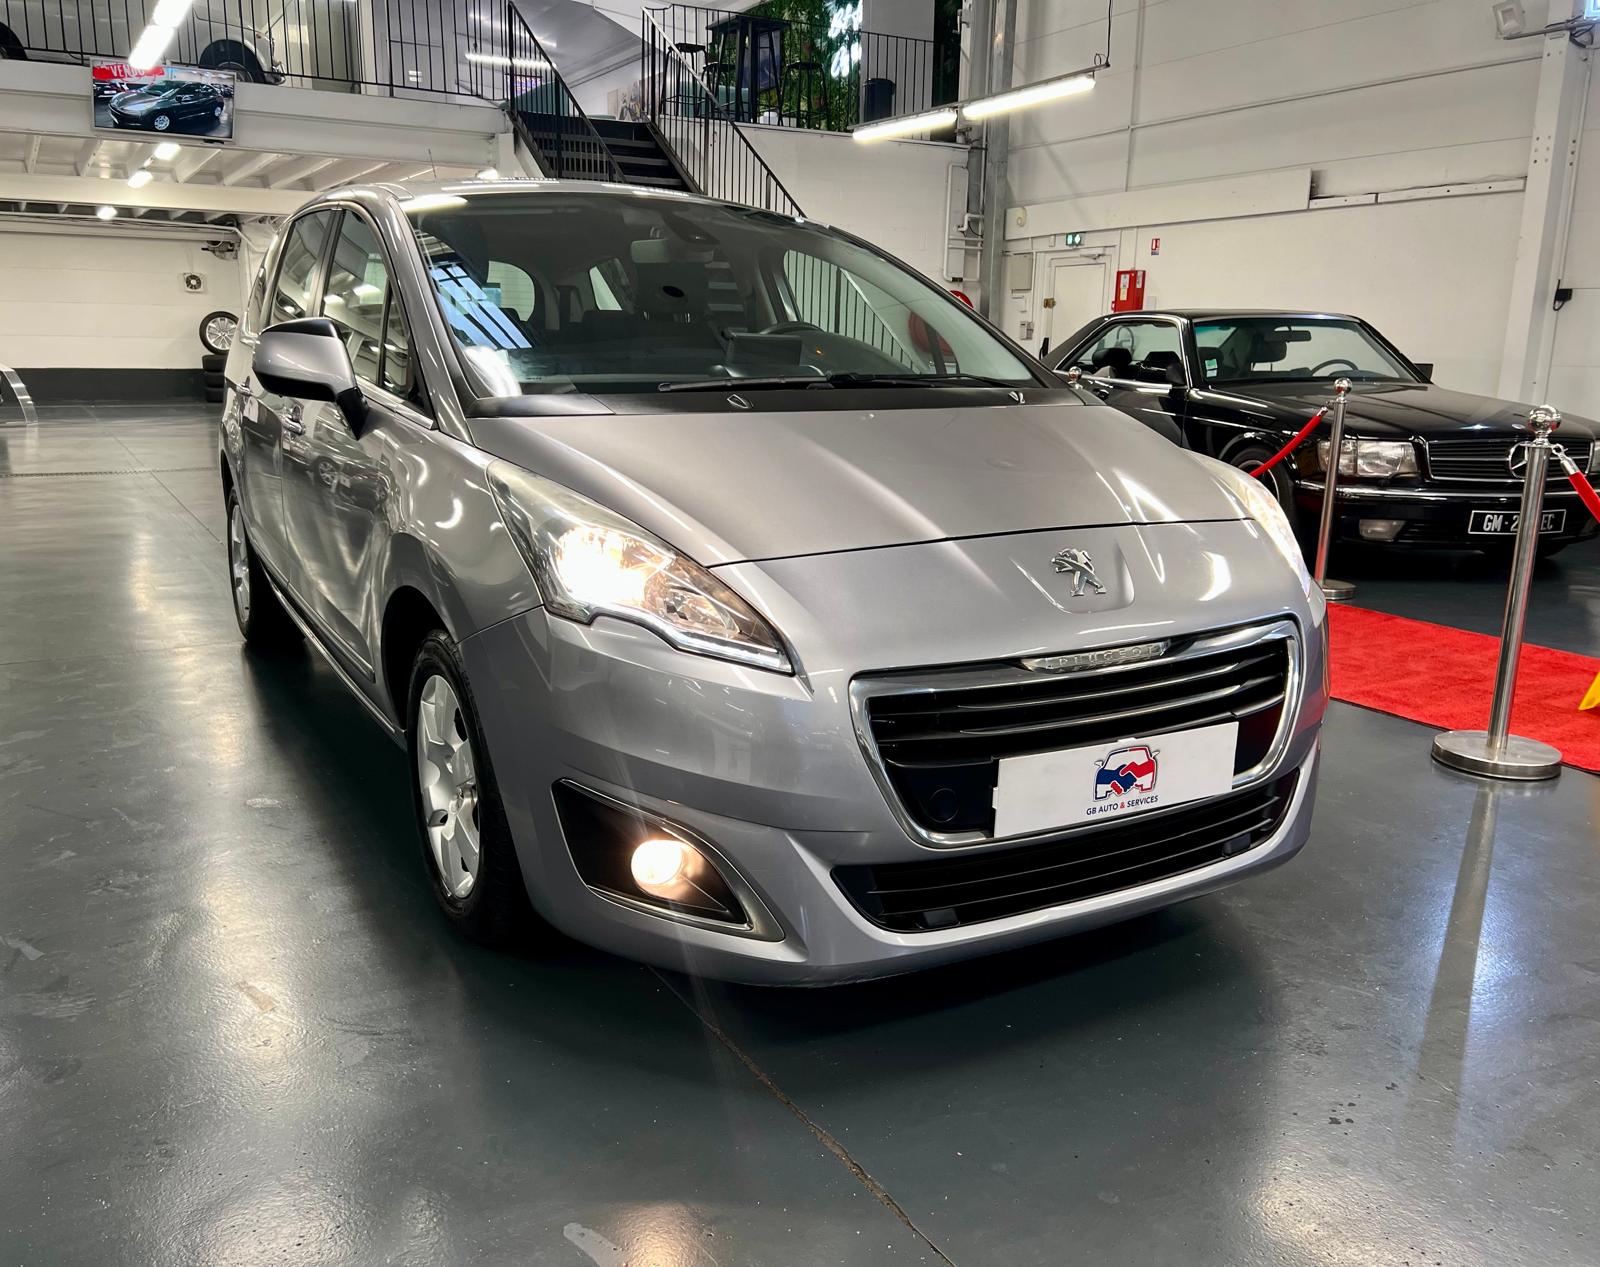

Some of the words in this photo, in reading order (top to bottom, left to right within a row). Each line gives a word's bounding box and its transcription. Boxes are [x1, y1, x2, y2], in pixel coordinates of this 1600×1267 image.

[1086, 807, 1097, 816] GB
[1098, 802, 1119, 813] AUTO
[1120, 801, 1125, 809] &
[1127, 795, 1159, 808] SERVICES
